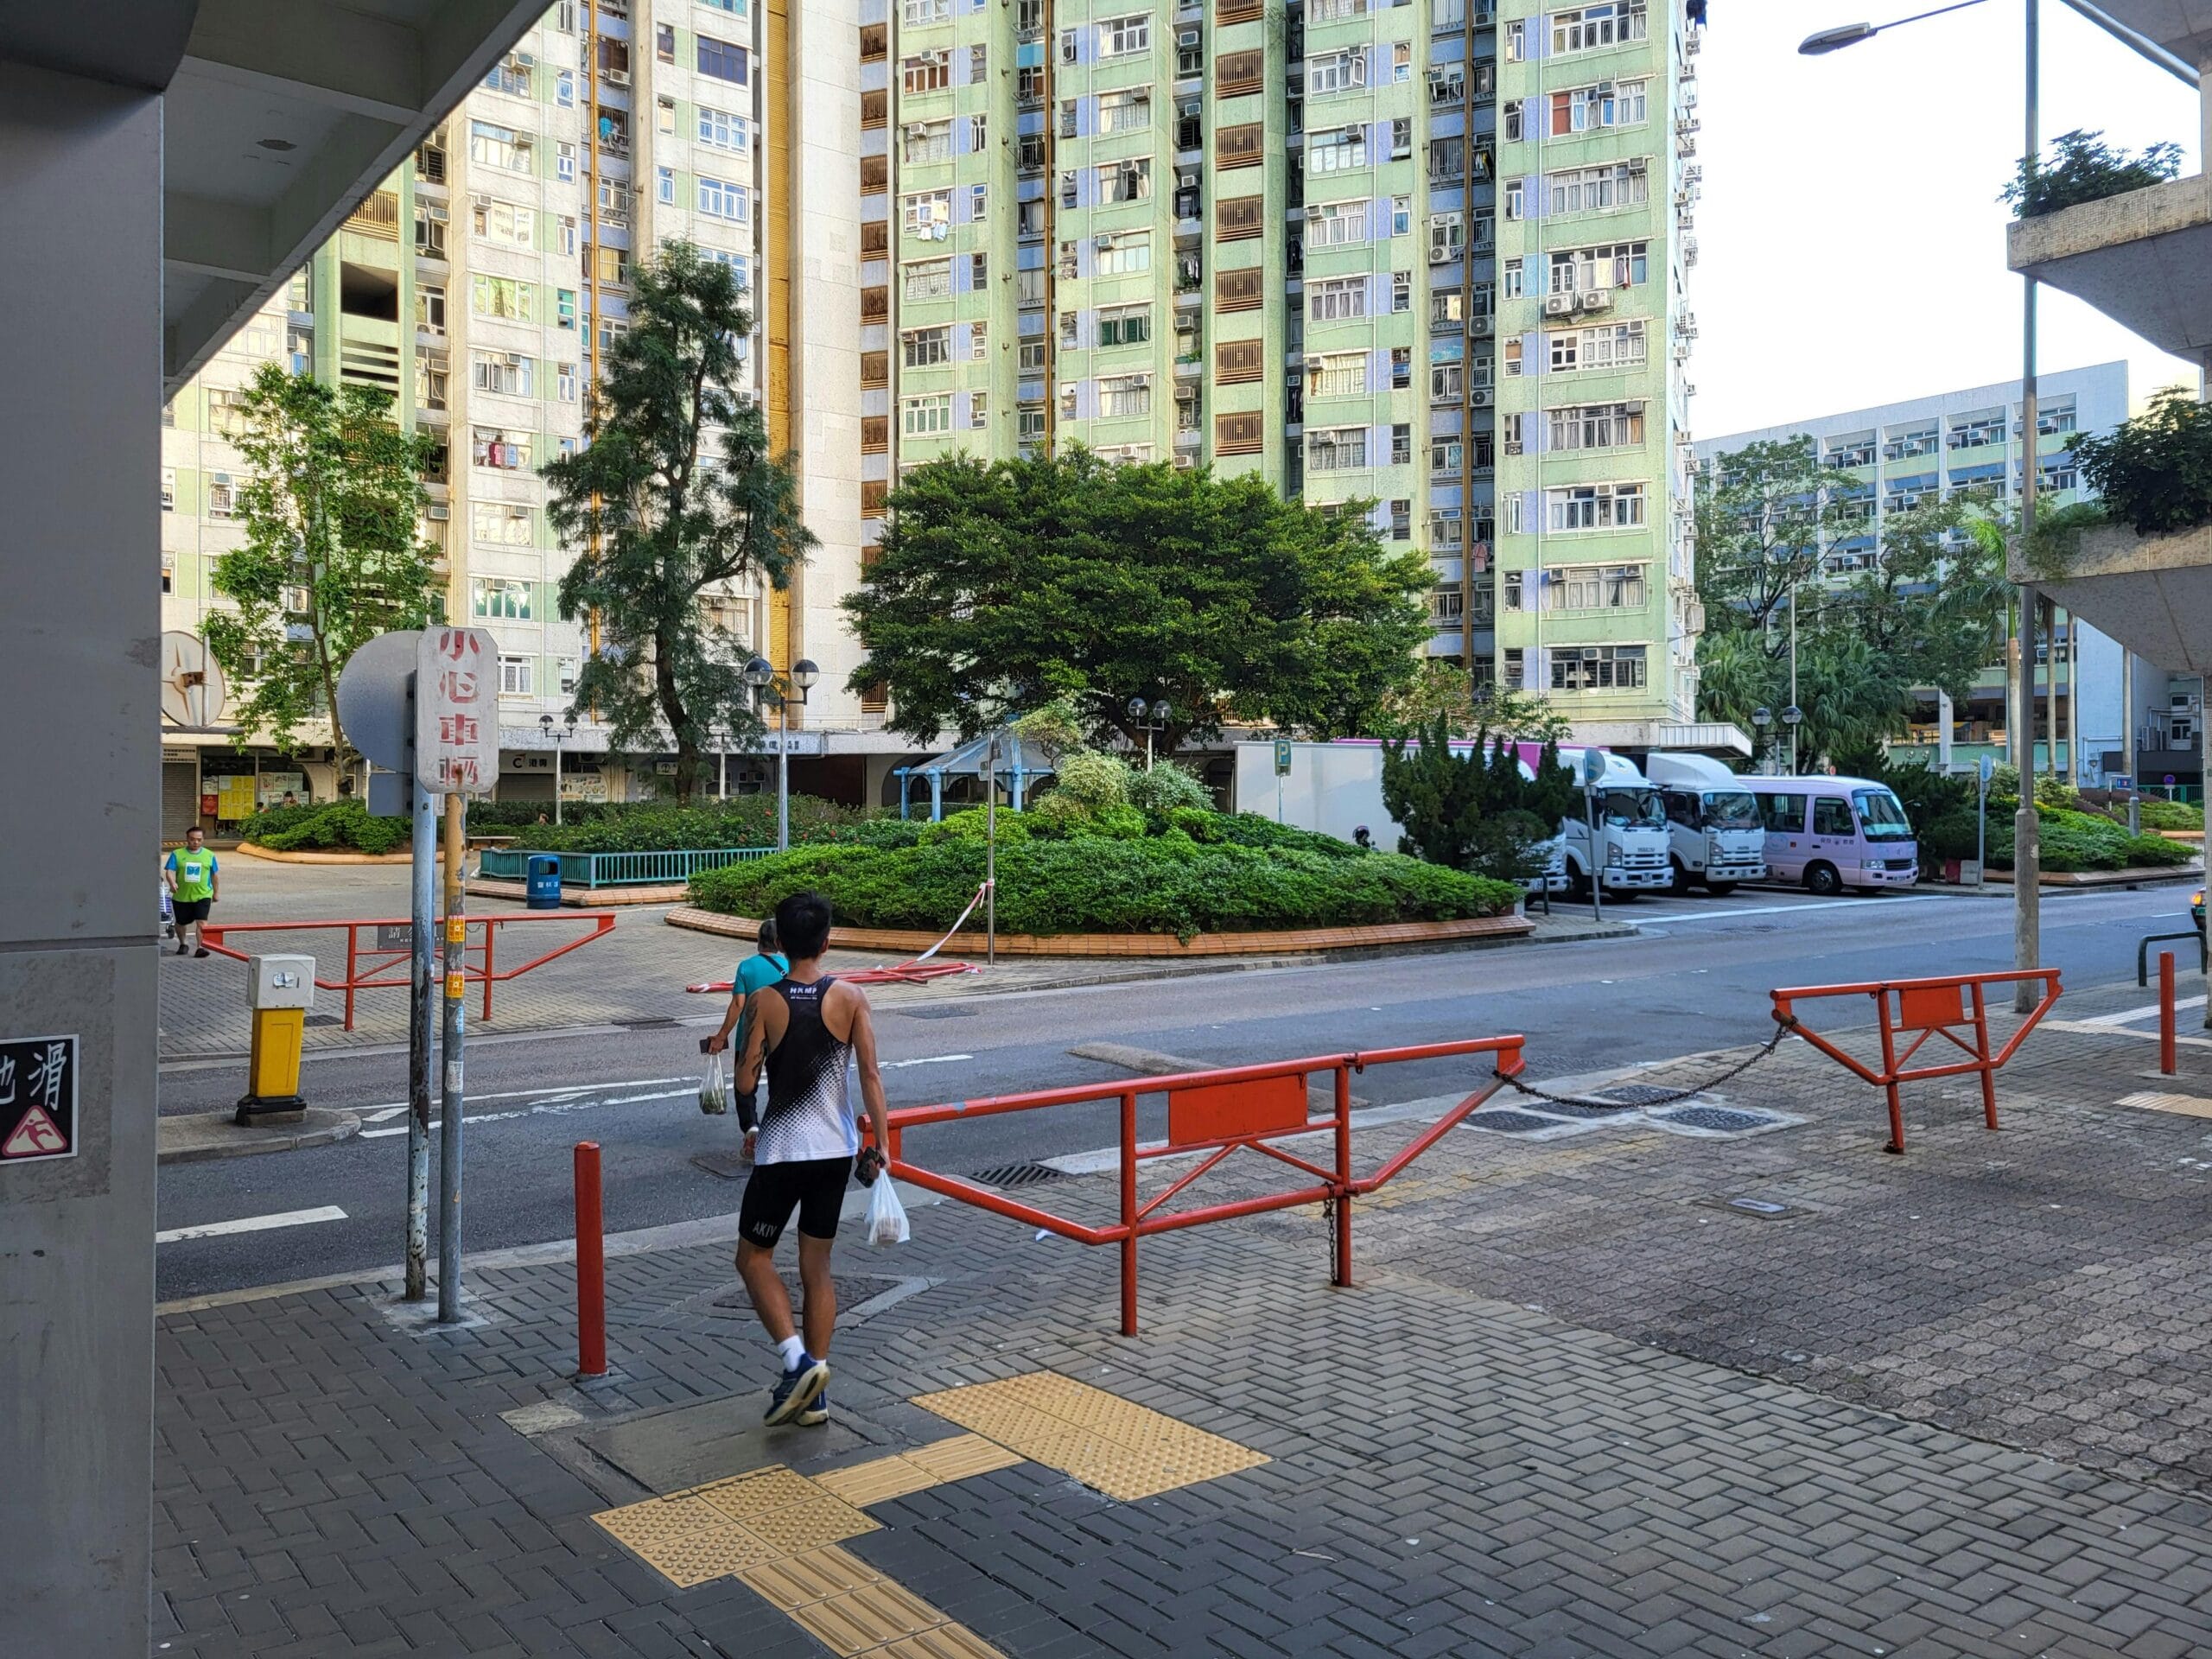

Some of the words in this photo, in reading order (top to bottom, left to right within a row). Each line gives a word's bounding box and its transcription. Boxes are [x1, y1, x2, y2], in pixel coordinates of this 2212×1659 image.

[439, 630, 480, 787] 小心車輛
[1278, 743, 1289, 763] P
